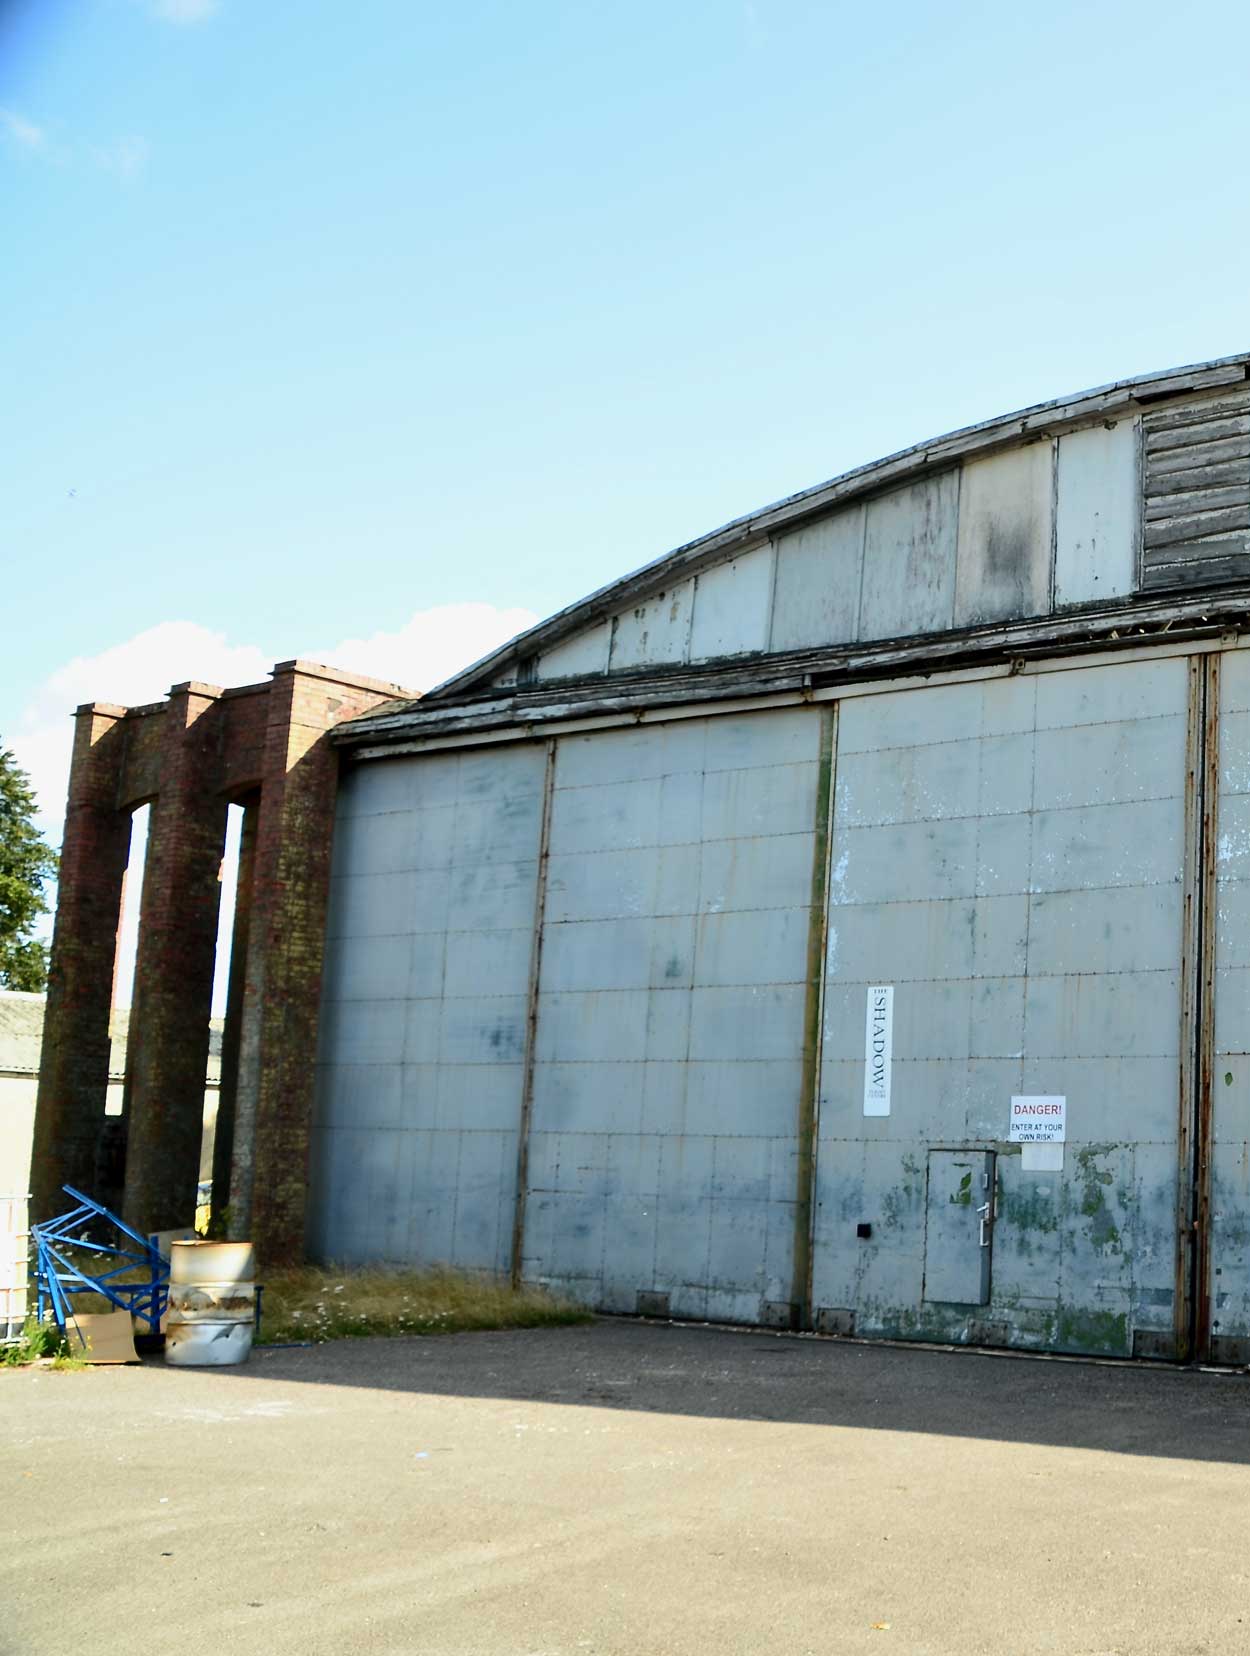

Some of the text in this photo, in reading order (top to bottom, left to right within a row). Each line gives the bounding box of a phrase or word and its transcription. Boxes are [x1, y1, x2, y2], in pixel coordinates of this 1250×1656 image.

[872, 996, 886, 1088] SHADOW
[1014, 1104, 1062, 1115] DANGER!
[1011, 1123, 1063, 1131] ENTER AT YOUR
[1018, 1133, 1035, 1141] OWN
